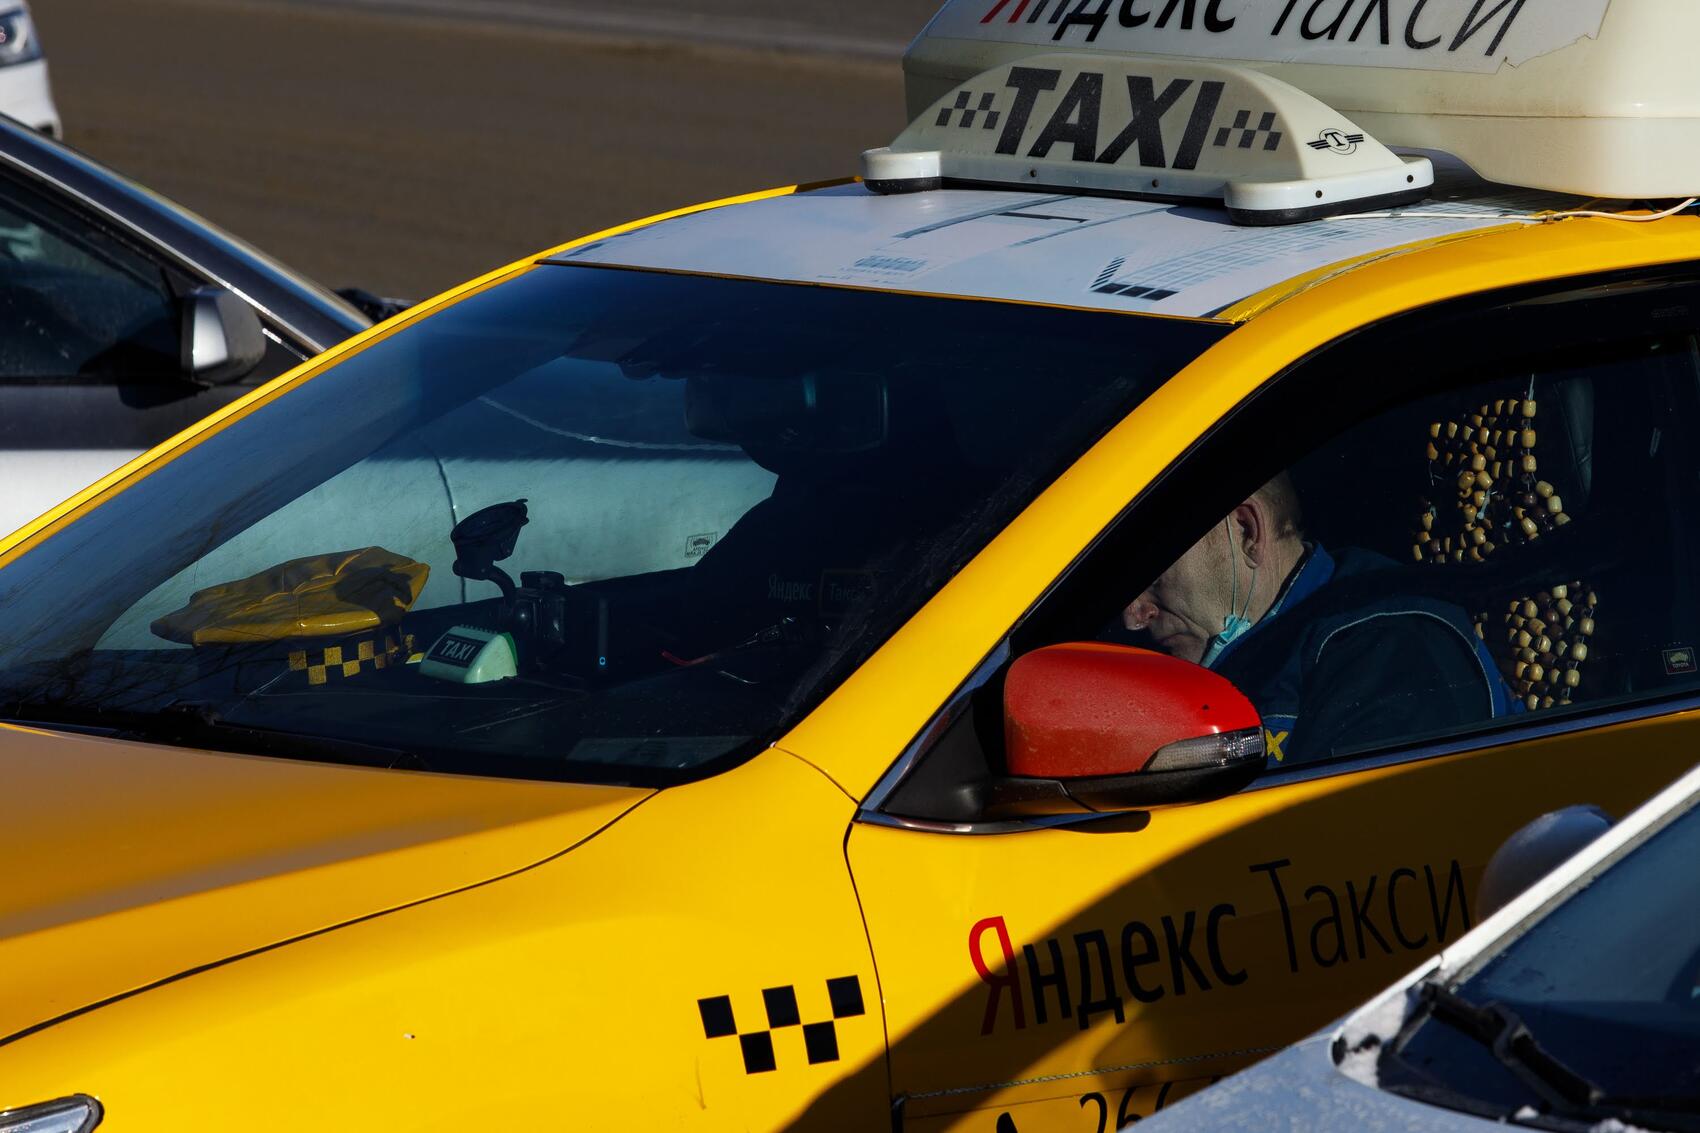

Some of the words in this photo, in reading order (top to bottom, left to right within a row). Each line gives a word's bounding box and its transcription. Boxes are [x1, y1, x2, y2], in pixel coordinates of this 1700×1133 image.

[995, 66, 1225, 170] TAXI
[768, 573, 813, 603] Яндекс
[440, 639, 477, 660] TAXI
[968, 903, 1248, 1036] Яндекс
[1249, 858, 1470, 973] Такси
